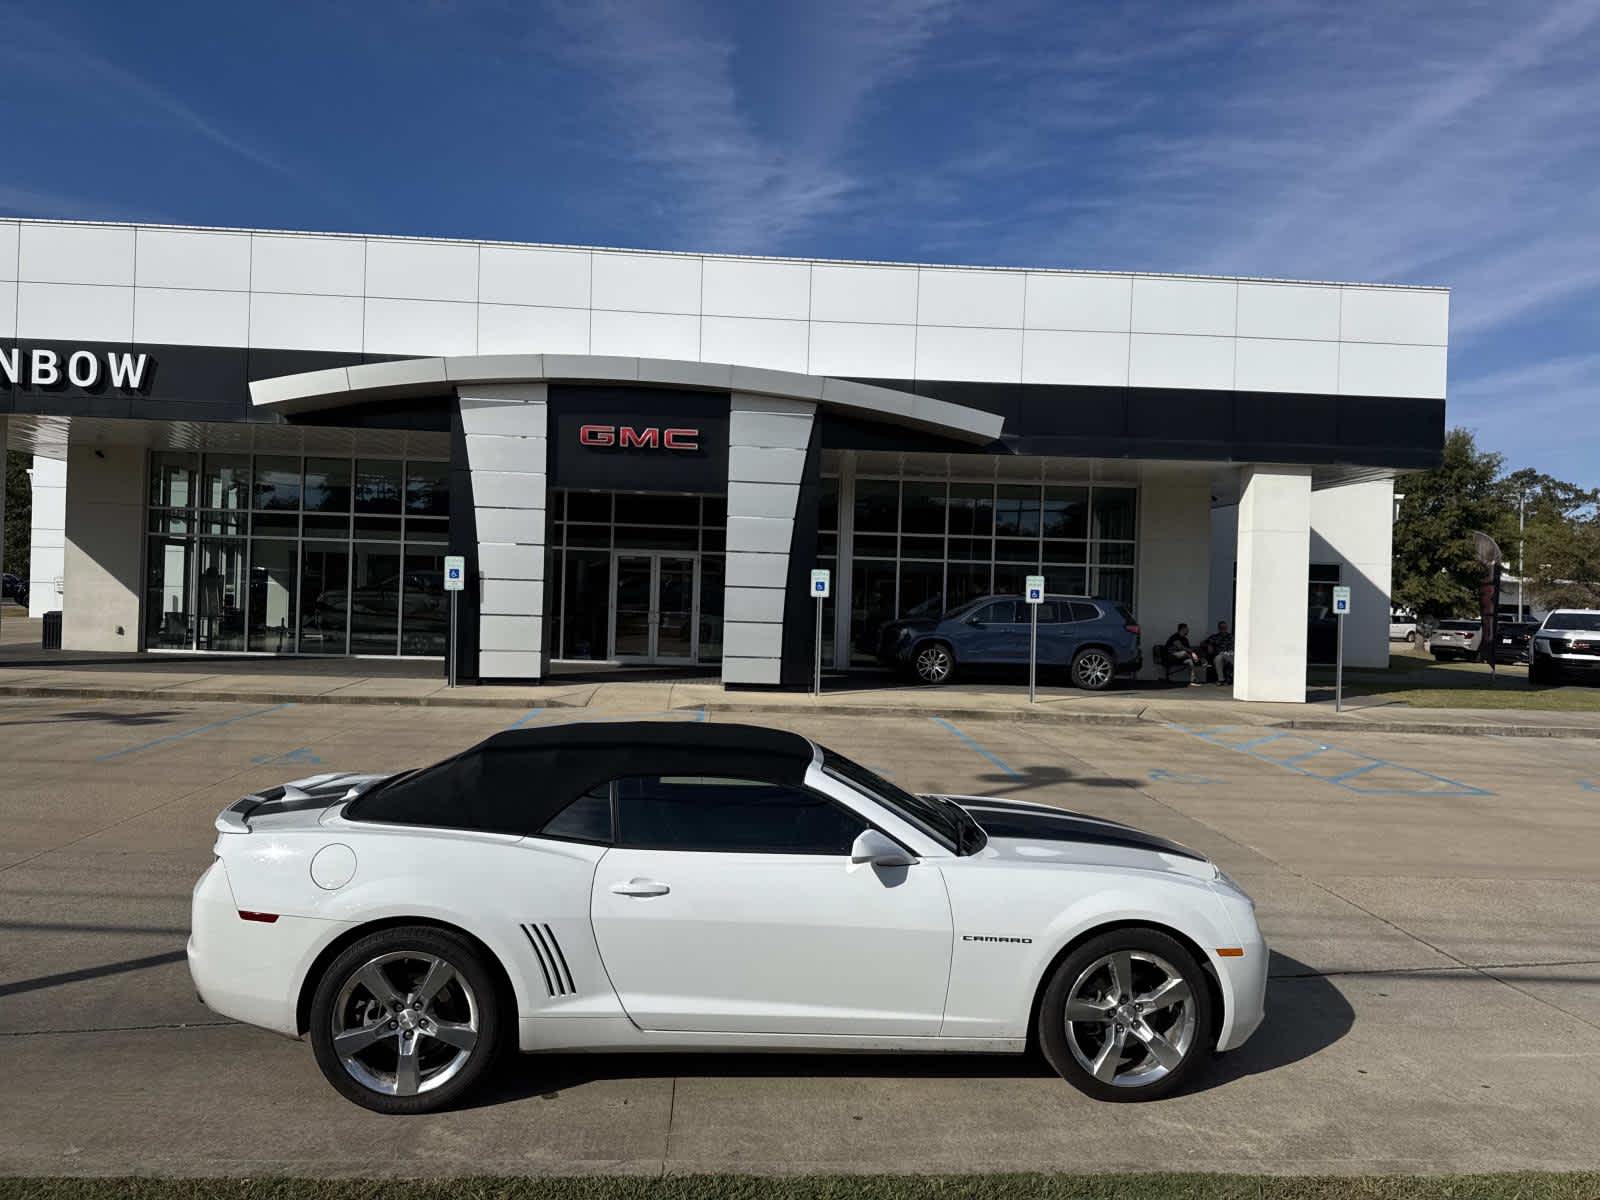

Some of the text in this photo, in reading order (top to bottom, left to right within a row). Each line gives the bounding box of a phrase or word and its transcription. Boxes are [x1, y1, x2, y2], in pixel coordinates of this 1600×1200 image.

[0, 348, 148, 389] NBOW
[579, 424, 699, 450] GMC
[962, 935, 1033, 944] CAMARO
